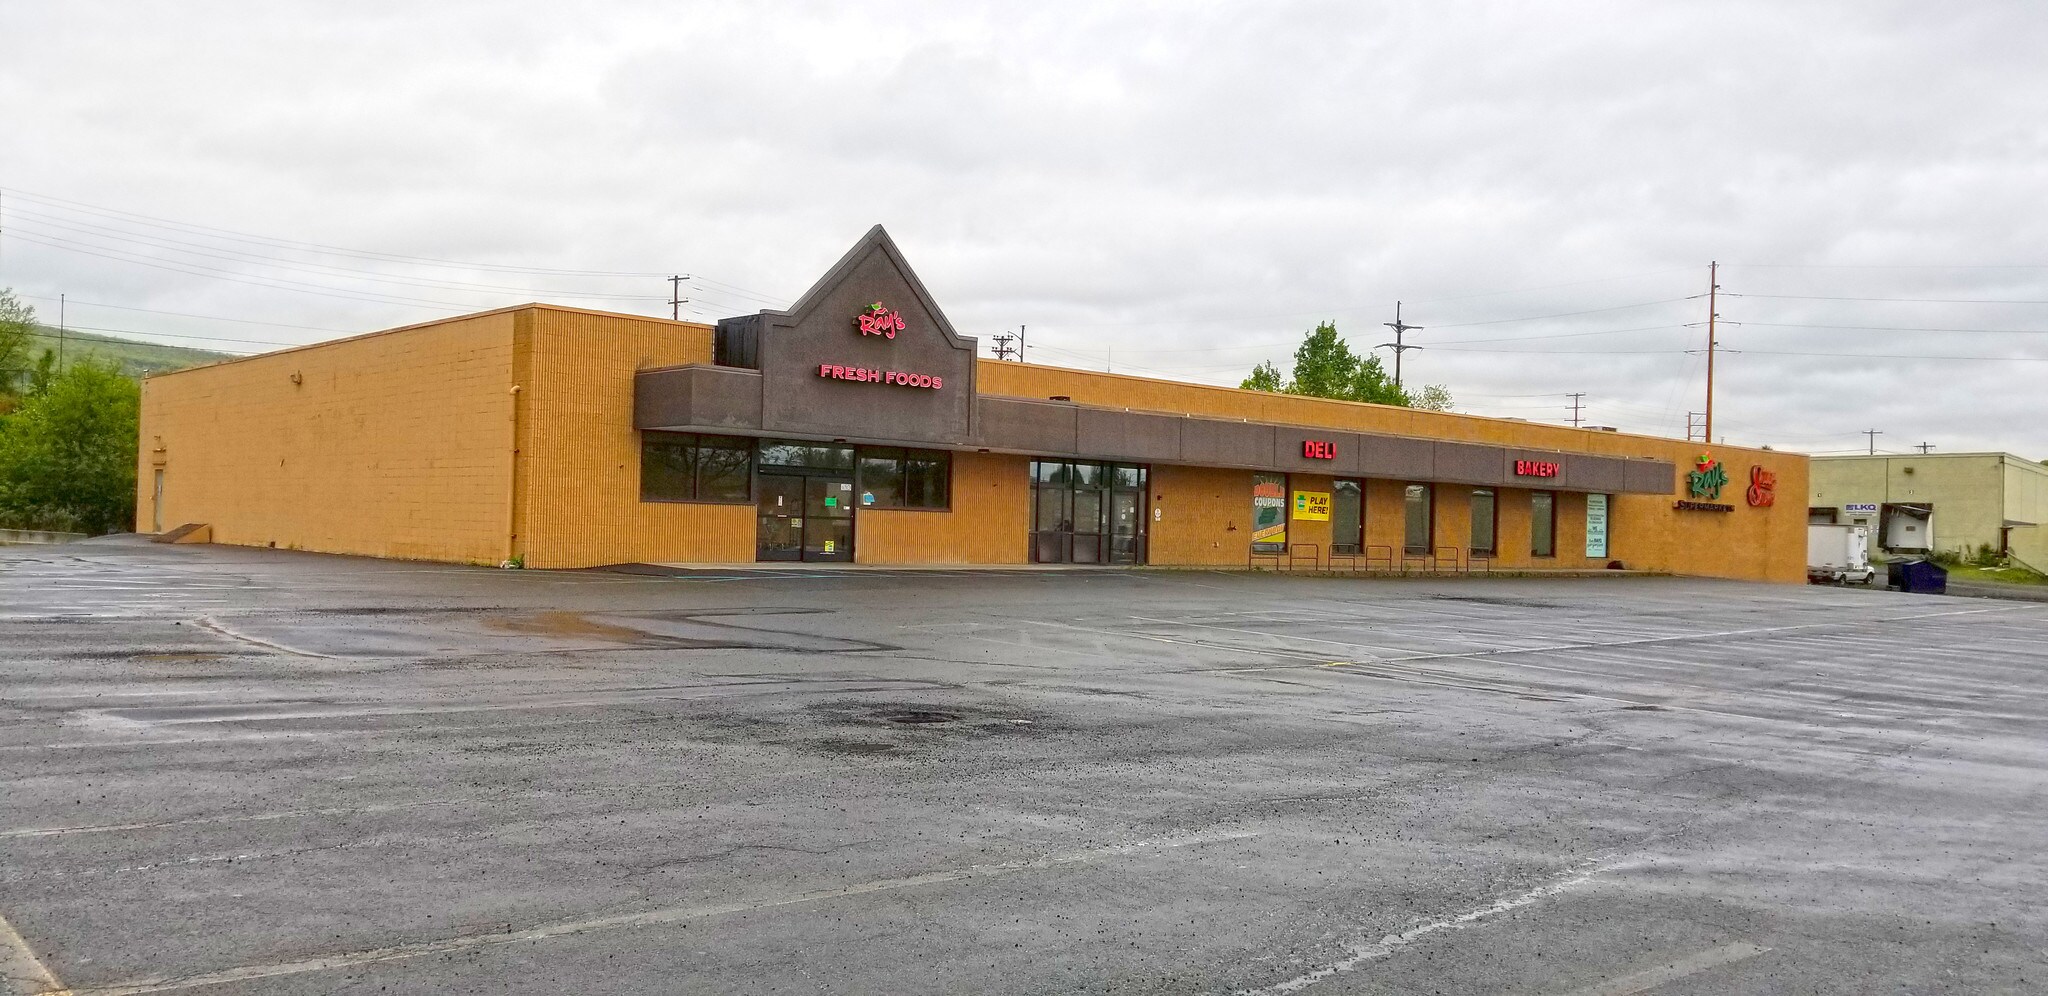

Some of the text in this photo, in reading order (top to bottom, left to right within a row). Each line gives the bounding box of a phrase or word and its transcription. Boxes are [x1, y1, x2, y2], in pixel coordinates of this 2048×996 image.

[858, 310, 906, 339] Ray's
[819, 363, 943, 390] FRESH FOODS
[1303, 440, 1337, 460] DELI
[1516, 460, 1560, 477] BAKERY
[1254, 497, 1285, 508] COUPONS
[1309, 496, 1328, 505] PLAY
[1308, 506, 1329, 515] HERE!
